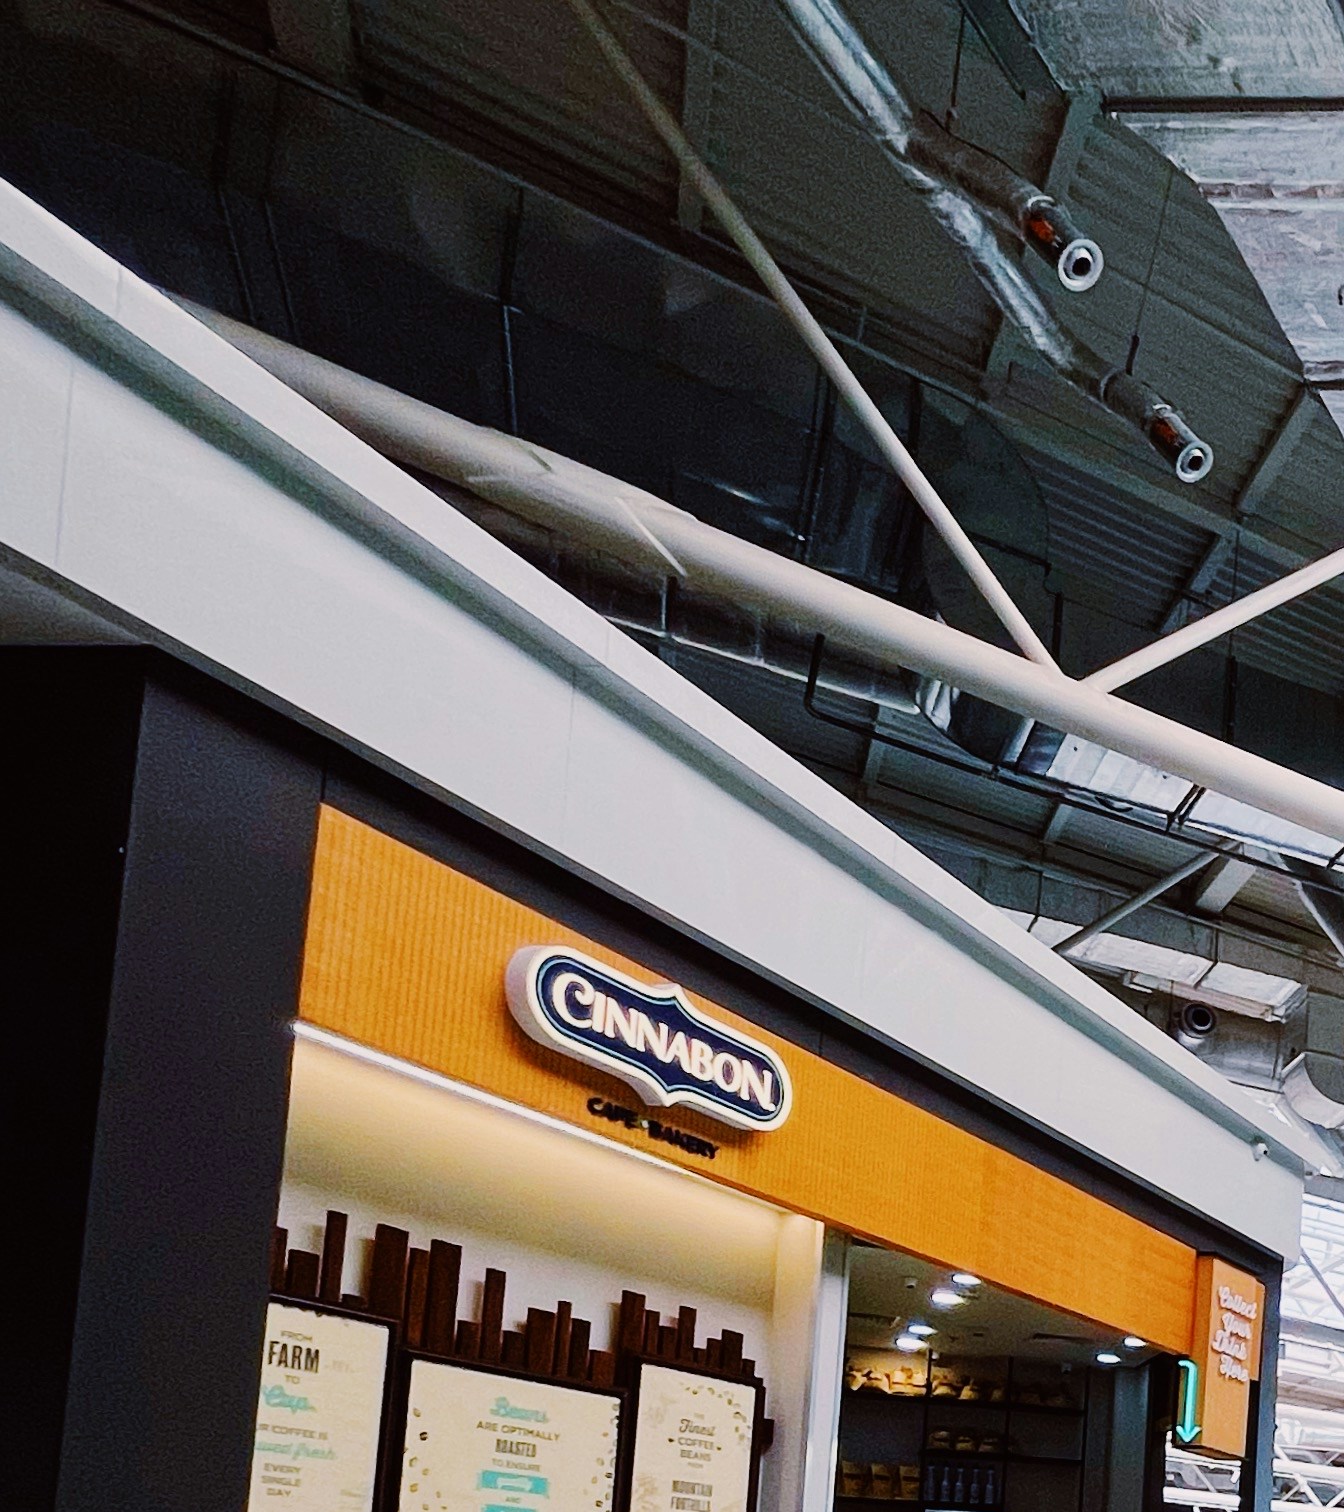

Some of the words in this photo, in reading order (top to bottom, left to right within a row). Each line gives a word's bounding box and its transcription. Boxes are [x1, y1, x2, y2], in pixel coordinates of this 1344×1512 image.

[552, 972, 776, 1112] CINNABON
[648, 1120, 719, 1160] BAKERY
[268, 1340, 320, 1374] FARM
[285, 1374, 301, 1386] TO
